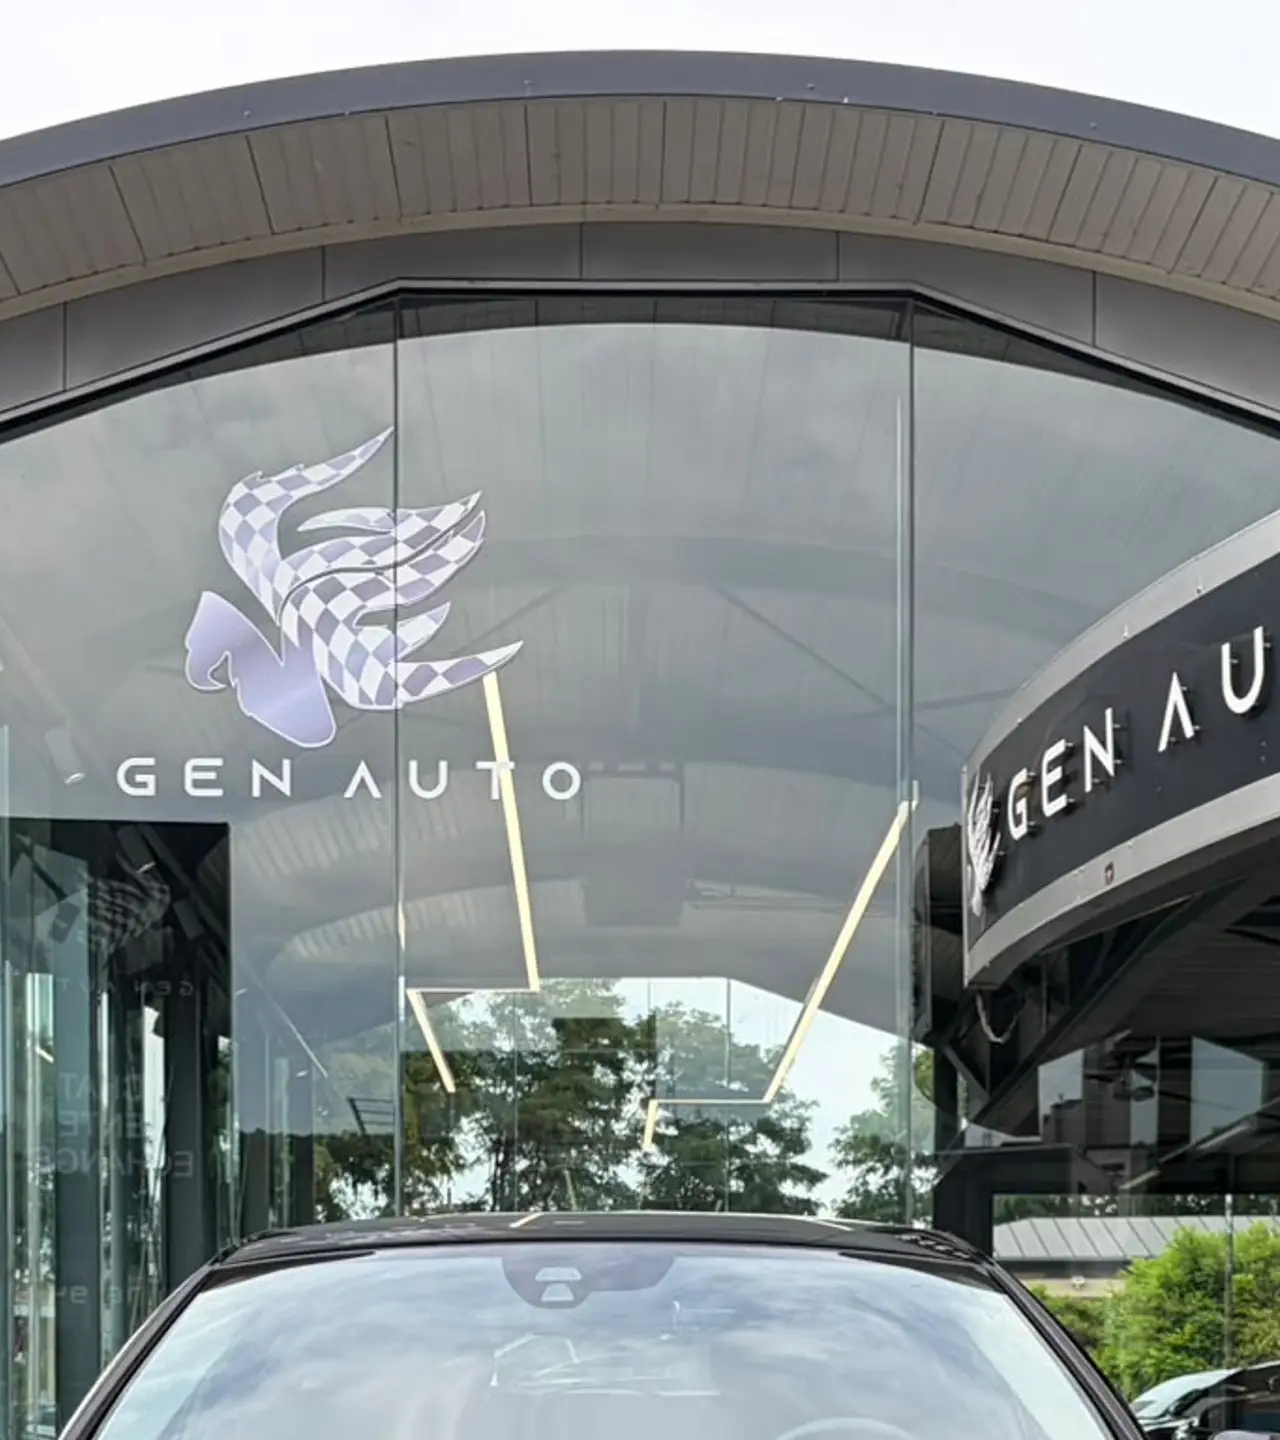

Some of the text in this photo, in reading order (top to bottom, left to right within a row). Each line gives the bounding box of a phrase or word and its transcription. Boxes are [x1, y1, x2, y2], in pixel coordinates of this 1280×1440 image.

[115, 756, 582, 801] GEN AUTO
[1006, 707, 1116, 841] GEN
